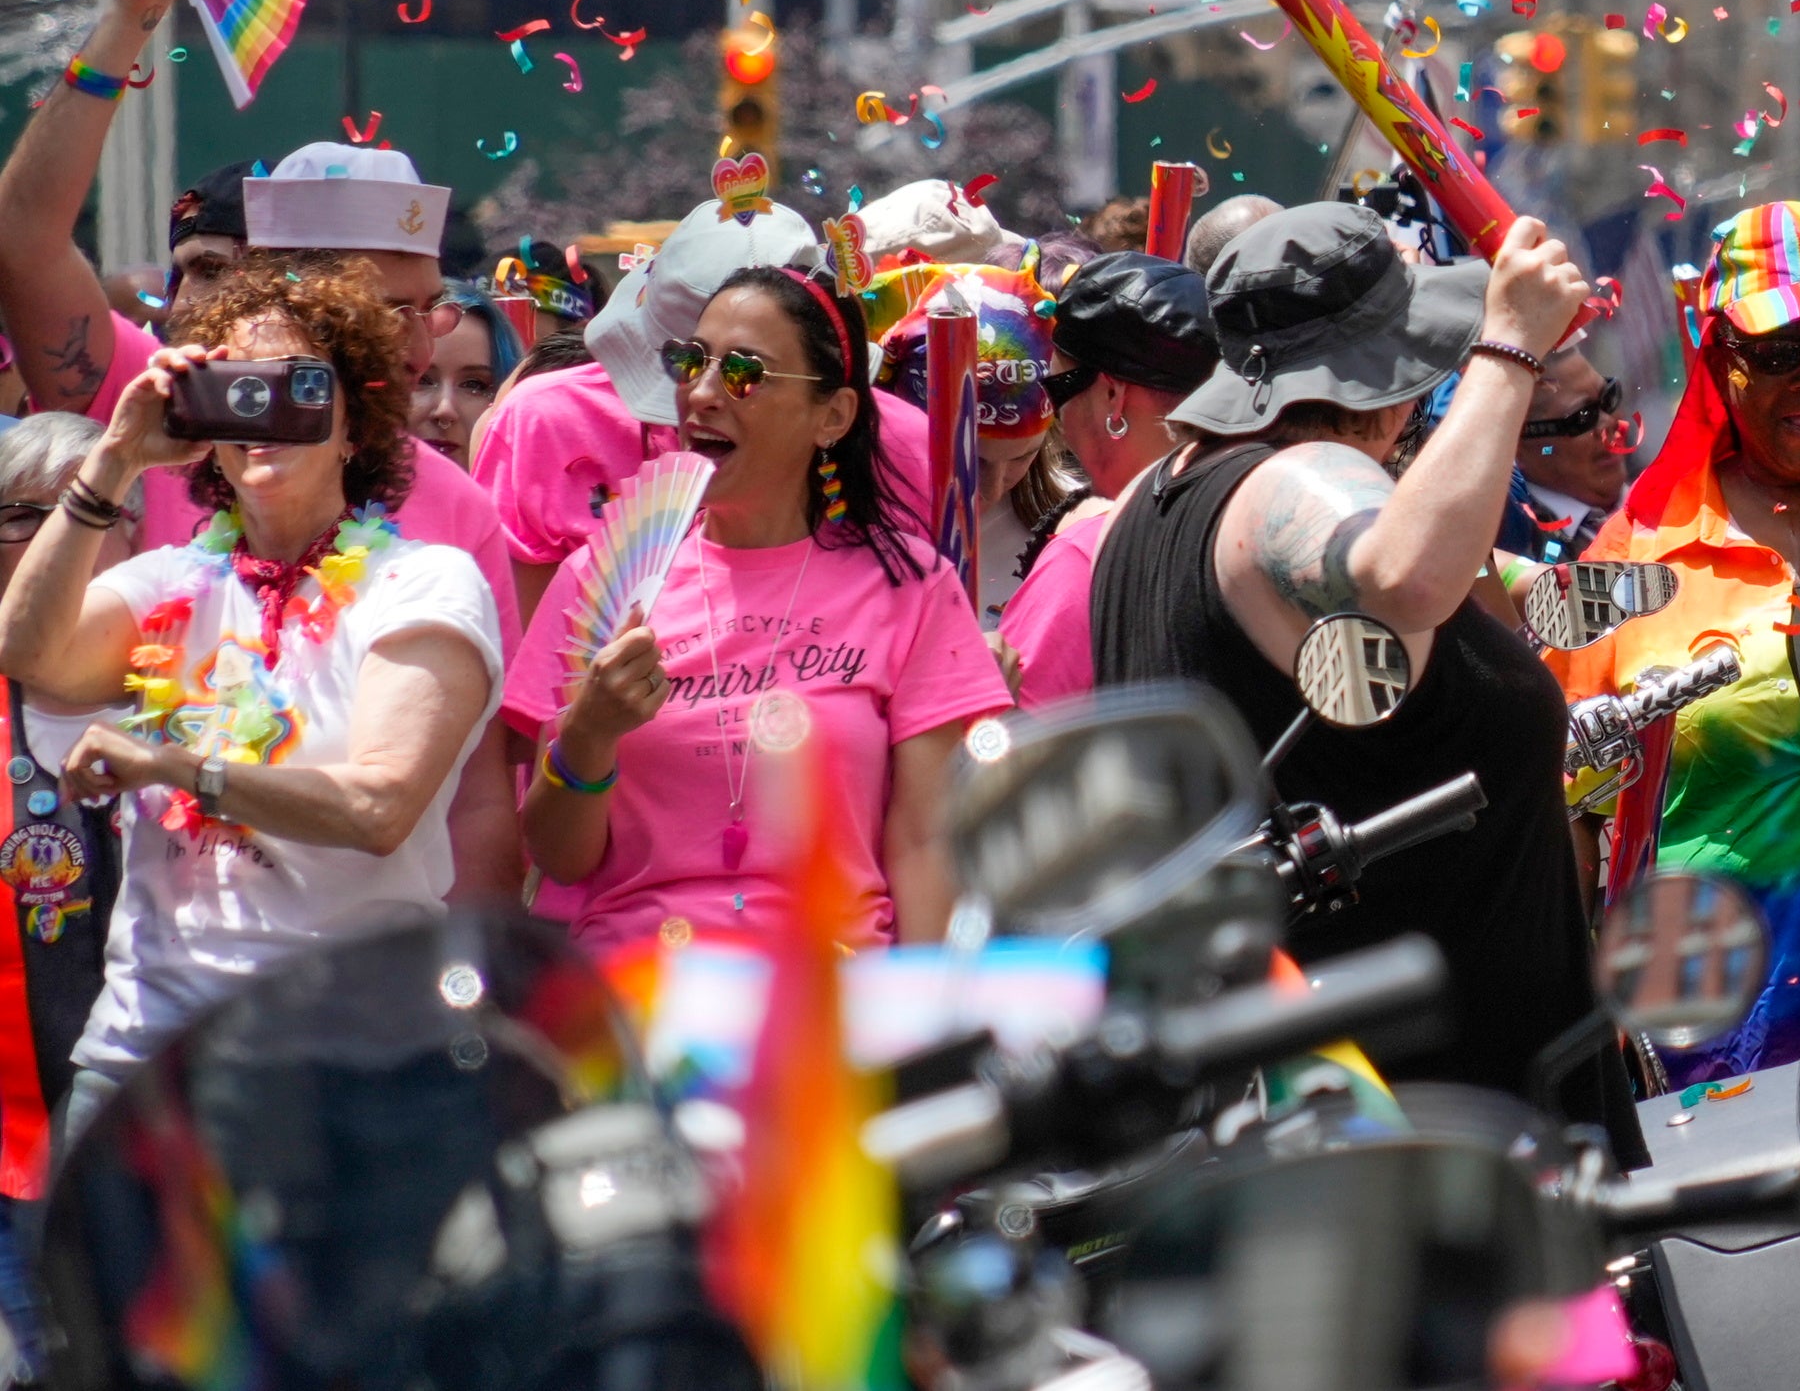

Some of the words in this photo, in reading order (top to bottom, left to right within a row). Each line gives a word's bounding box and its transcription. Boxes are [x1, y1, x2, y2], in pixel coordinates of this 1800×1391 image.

[666, 662, 780, 711] mpire
[776, 642, 868, 685] City
[0, 827, 28, 871] MOVING
[26, 823, 85, 867] VIOLATIONS
[20, 889, 67, 905] BOSTON
